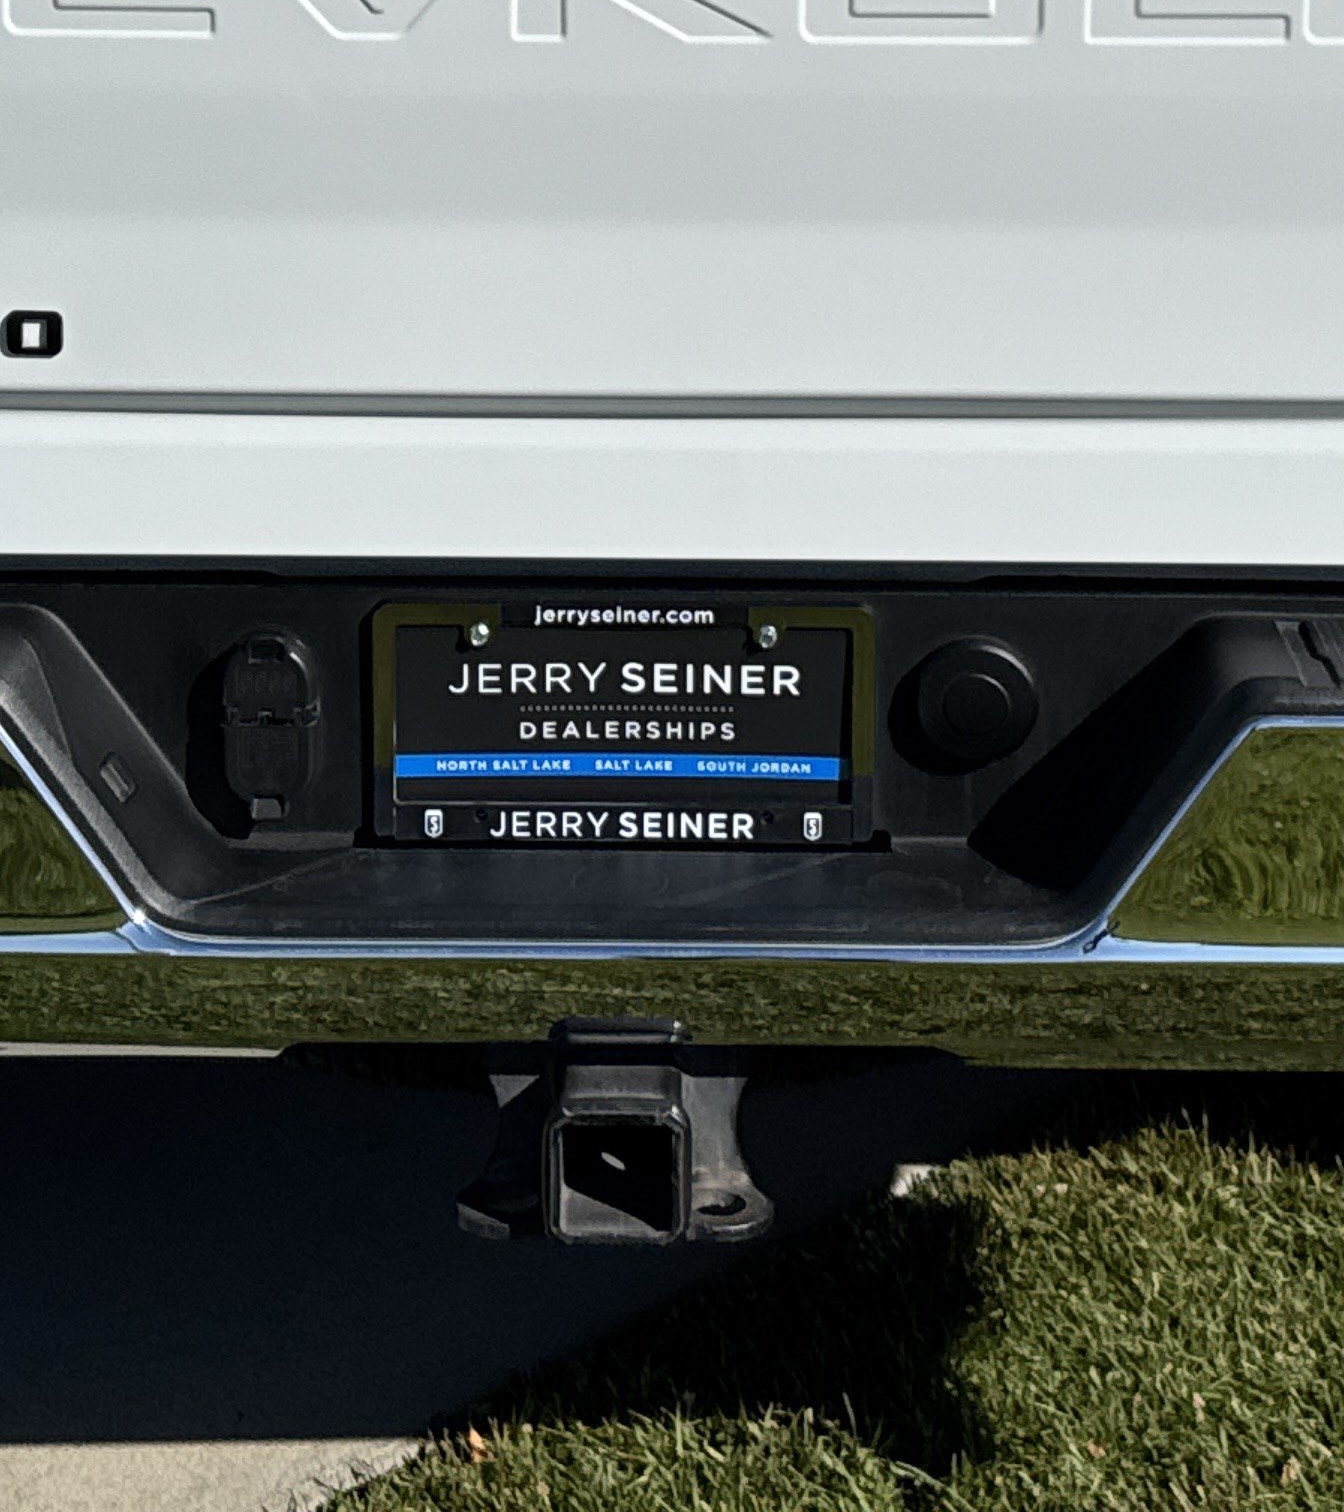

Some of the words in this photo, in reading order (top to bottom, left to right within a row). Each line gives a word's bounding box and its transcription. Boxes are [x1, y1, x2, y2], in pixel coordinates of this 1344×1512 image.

[534, 604, 715, 627] jerryseiner.com
[448, 661, 607, 694] JERRY
[620, 662, 801, 696] SEINER
[519, 720, 737, 740] DEALERSHIPS
[436, 759, 487, 771] NORTH
[492, 759, 528, 771] SALT
[532, 759, 571, 771] LAKE
[595, 759, 630, 771] SALT
[635, 760, 673, 772] LAKE
[697, 761, 746, 773] SOUTH
[751, 762, 812, 774] JORDAN
[489, 811, 610, 838] JERRY
[618, 812, 755, 839] SEINER
